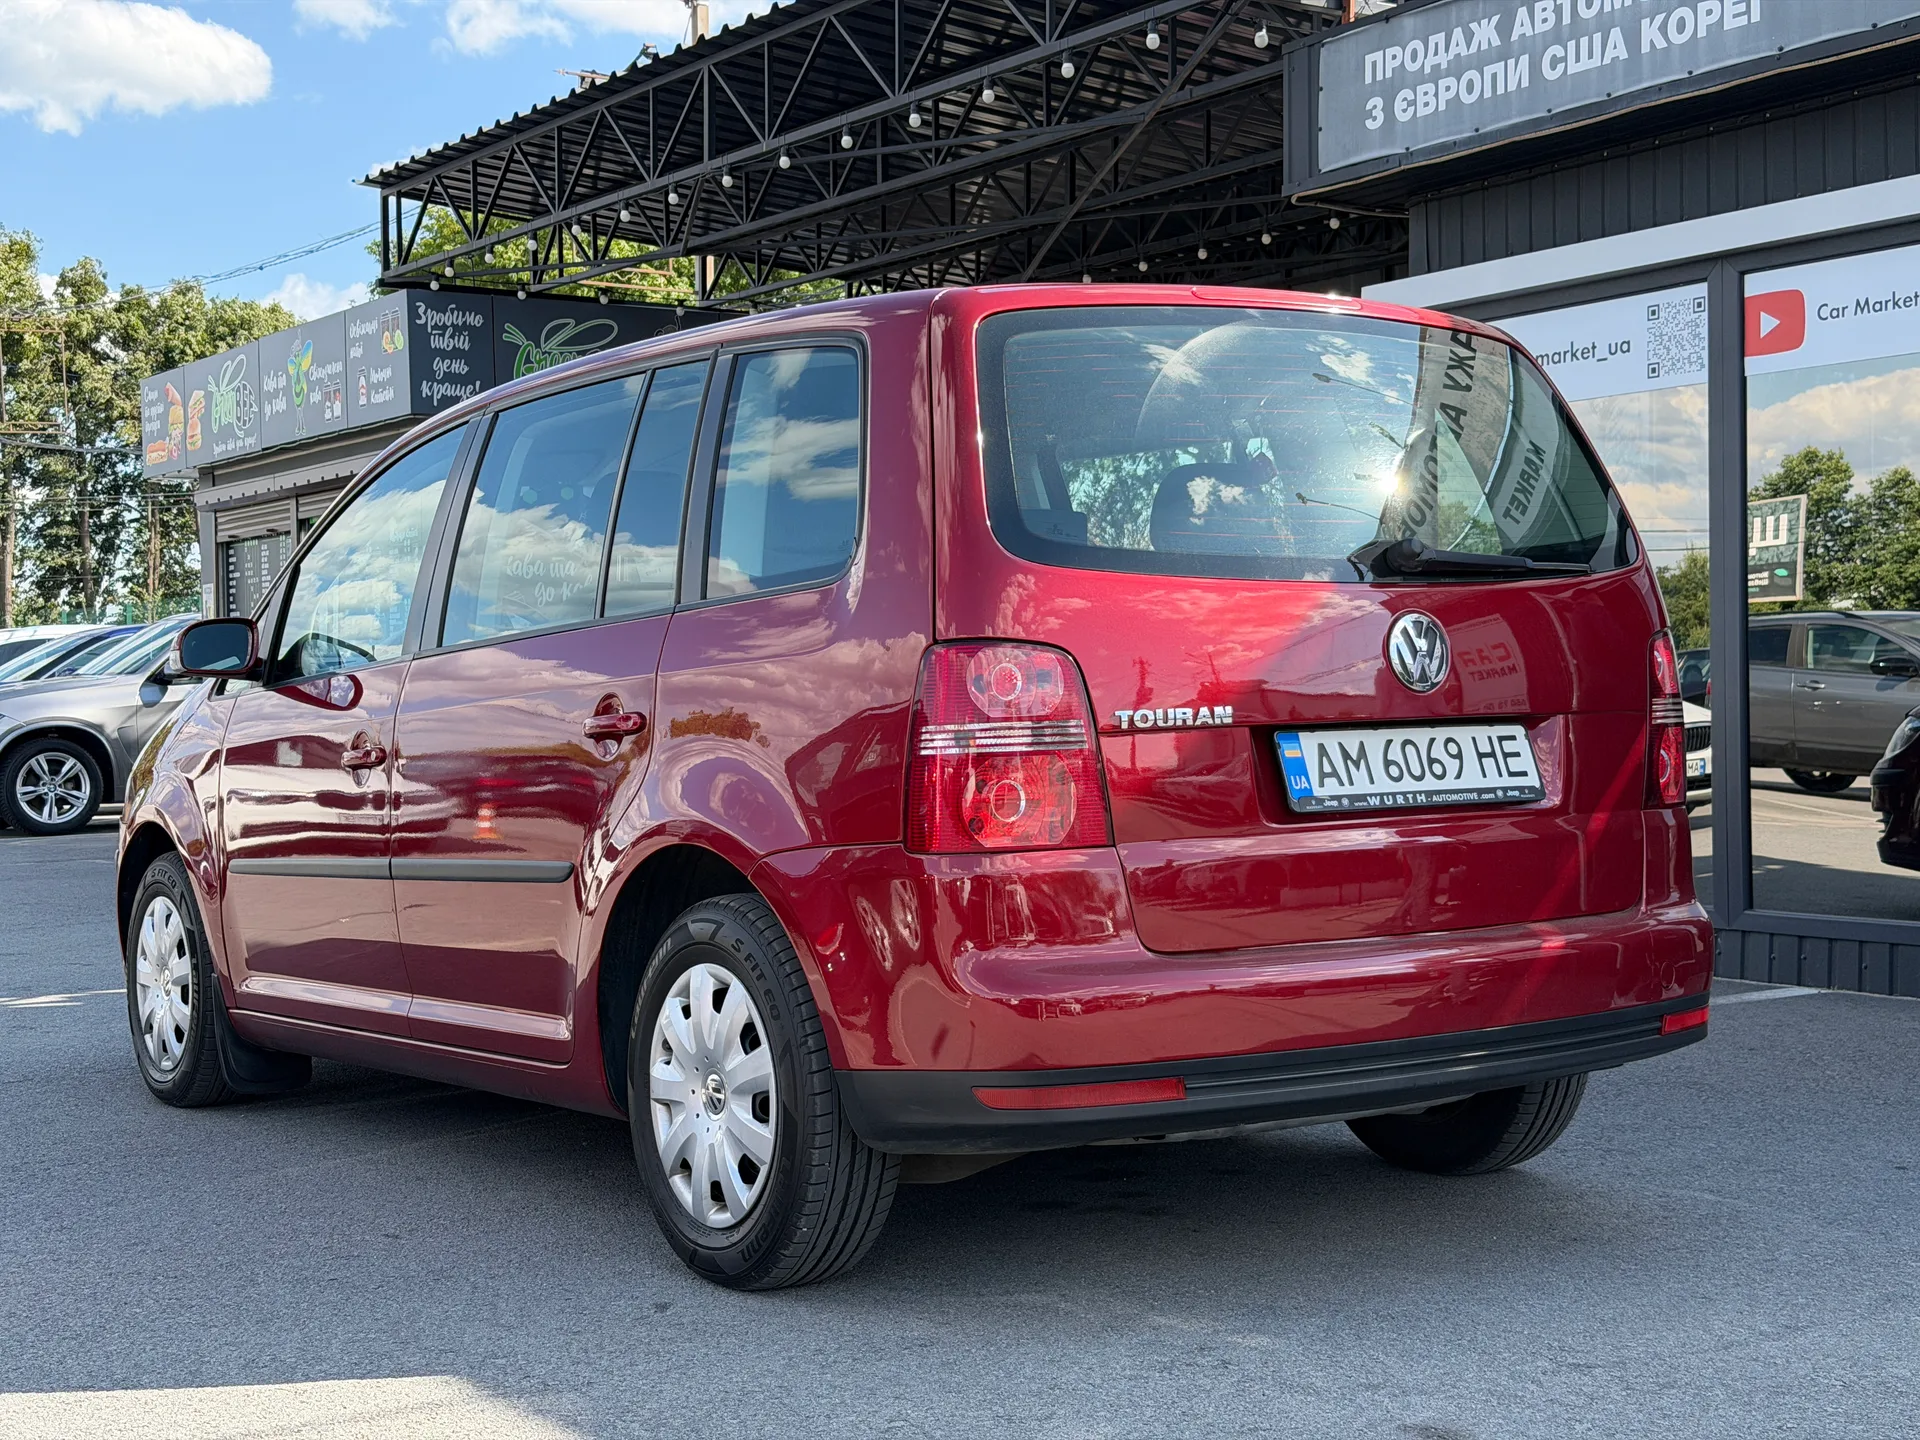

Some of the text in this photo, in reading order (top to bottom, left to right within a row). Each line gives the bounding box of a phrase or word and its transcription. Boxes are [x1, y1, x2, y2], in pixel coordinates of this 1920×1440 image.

[1365, 14, 1501, 84] ПРОДАЖ
[1365, 97, 1384, 130] З
[1394, 54, 1529, 122] ЄВРОПИ
[1542, 27, 1628, 80] США
[415, 302, 484, 332] Зробимо
[1817, 293, 1920, 321] Car Market
[430, 326, 471, 351] твій
[1535, 337, 1631, 366] market_ua
[433, 357, 470, 379] день
[514, 341, 582, 379] Gree
[420, 380, 480, 406] краще!
[535, 582, 555, 608] до
[1115, 706, 1233, 729] TOURAN
[1317, 734, 1529, 788] AM 6069 HE
[1290, 775, 1310, 790] UA
[1366, 793, 1427, 806] WURTH
[1432, 792, 1478, 802] AUTOMOTIVE
[744, 952, 768, 983] FIT
